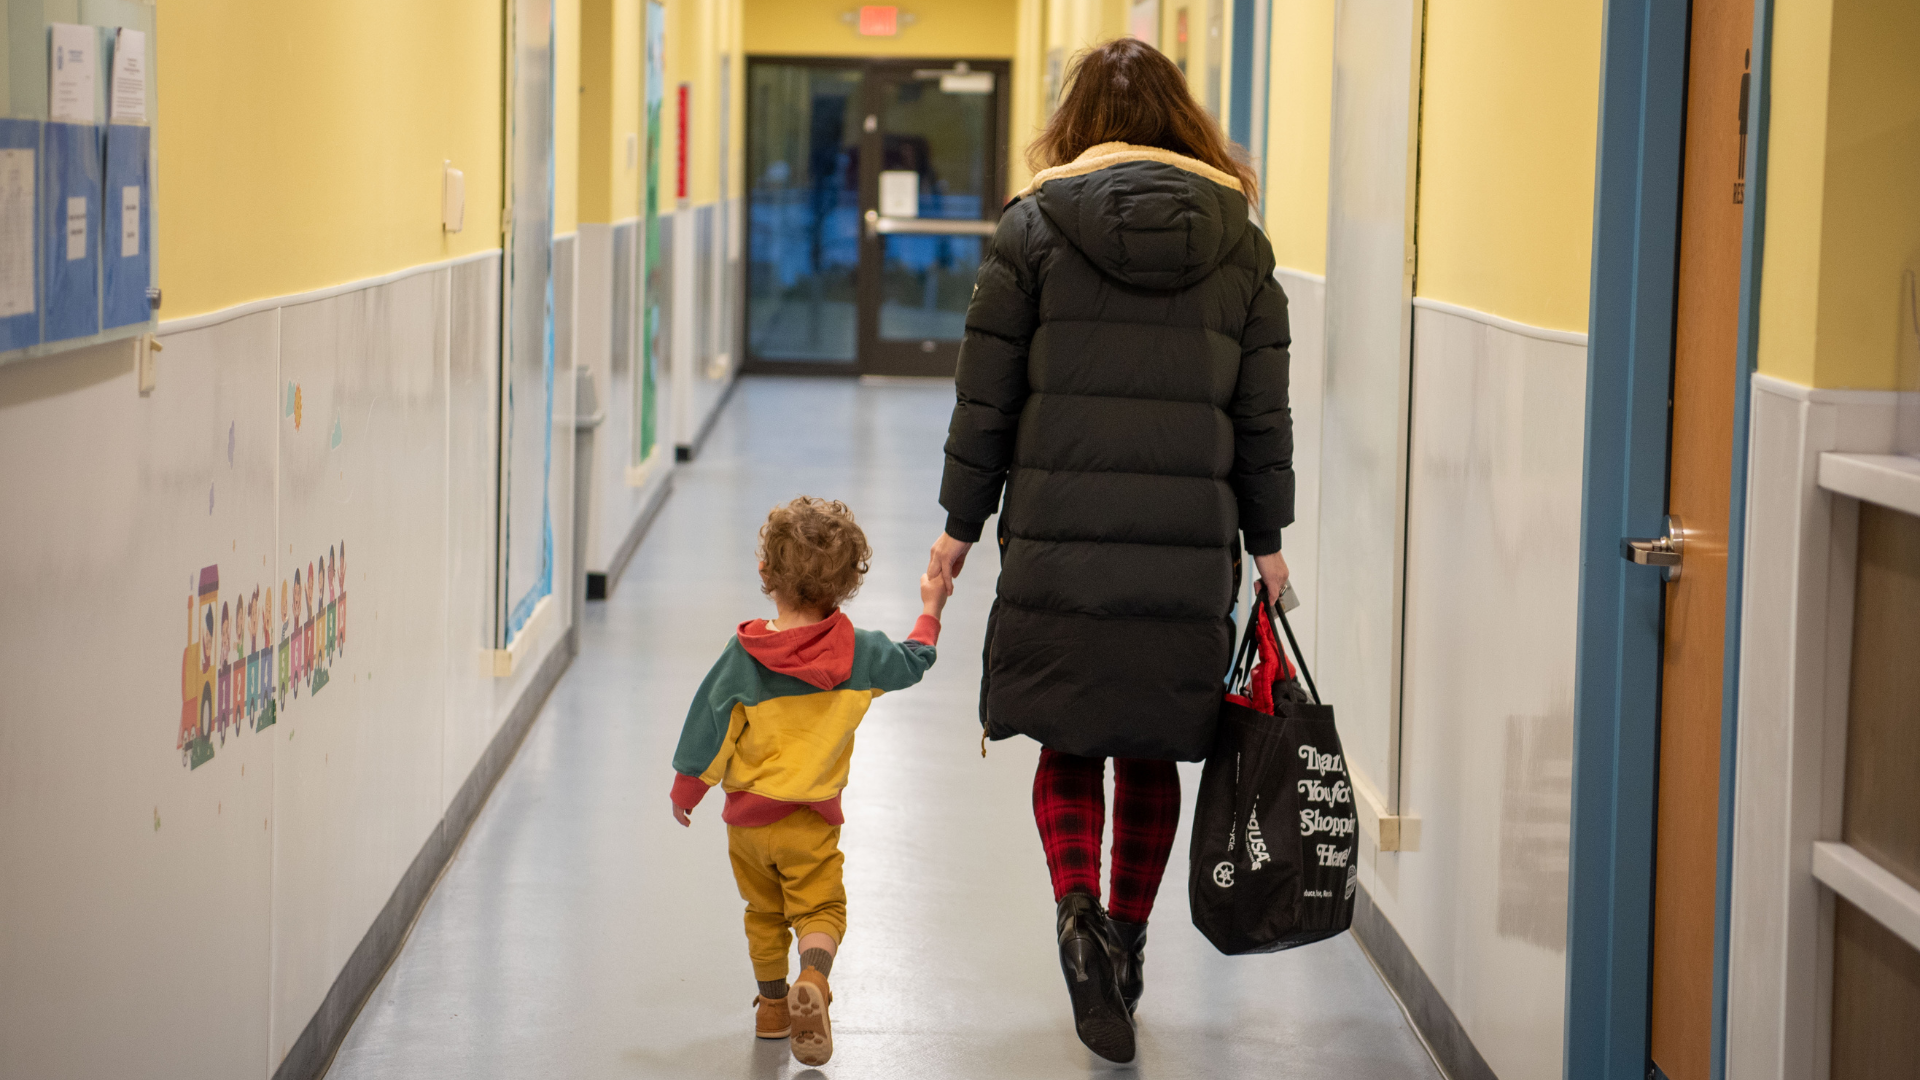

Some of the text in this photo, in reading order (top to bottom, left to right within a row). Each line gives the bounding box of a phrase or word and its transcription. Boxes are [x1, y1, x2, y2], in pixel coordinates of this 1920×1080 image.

[1733, 183, 1745, 205] RES
[222, 680, 226, 710] 1
[237, 672, 242, 701] 2
[251, 666, 255, 694] 3
[264, 660, 268, 687] 4
[281, 652, 285, 679] 5
[295, 641, 298, 667] 6
[308, 630, 311, 656] 7
[1298, 744, 1347, 776] Than
